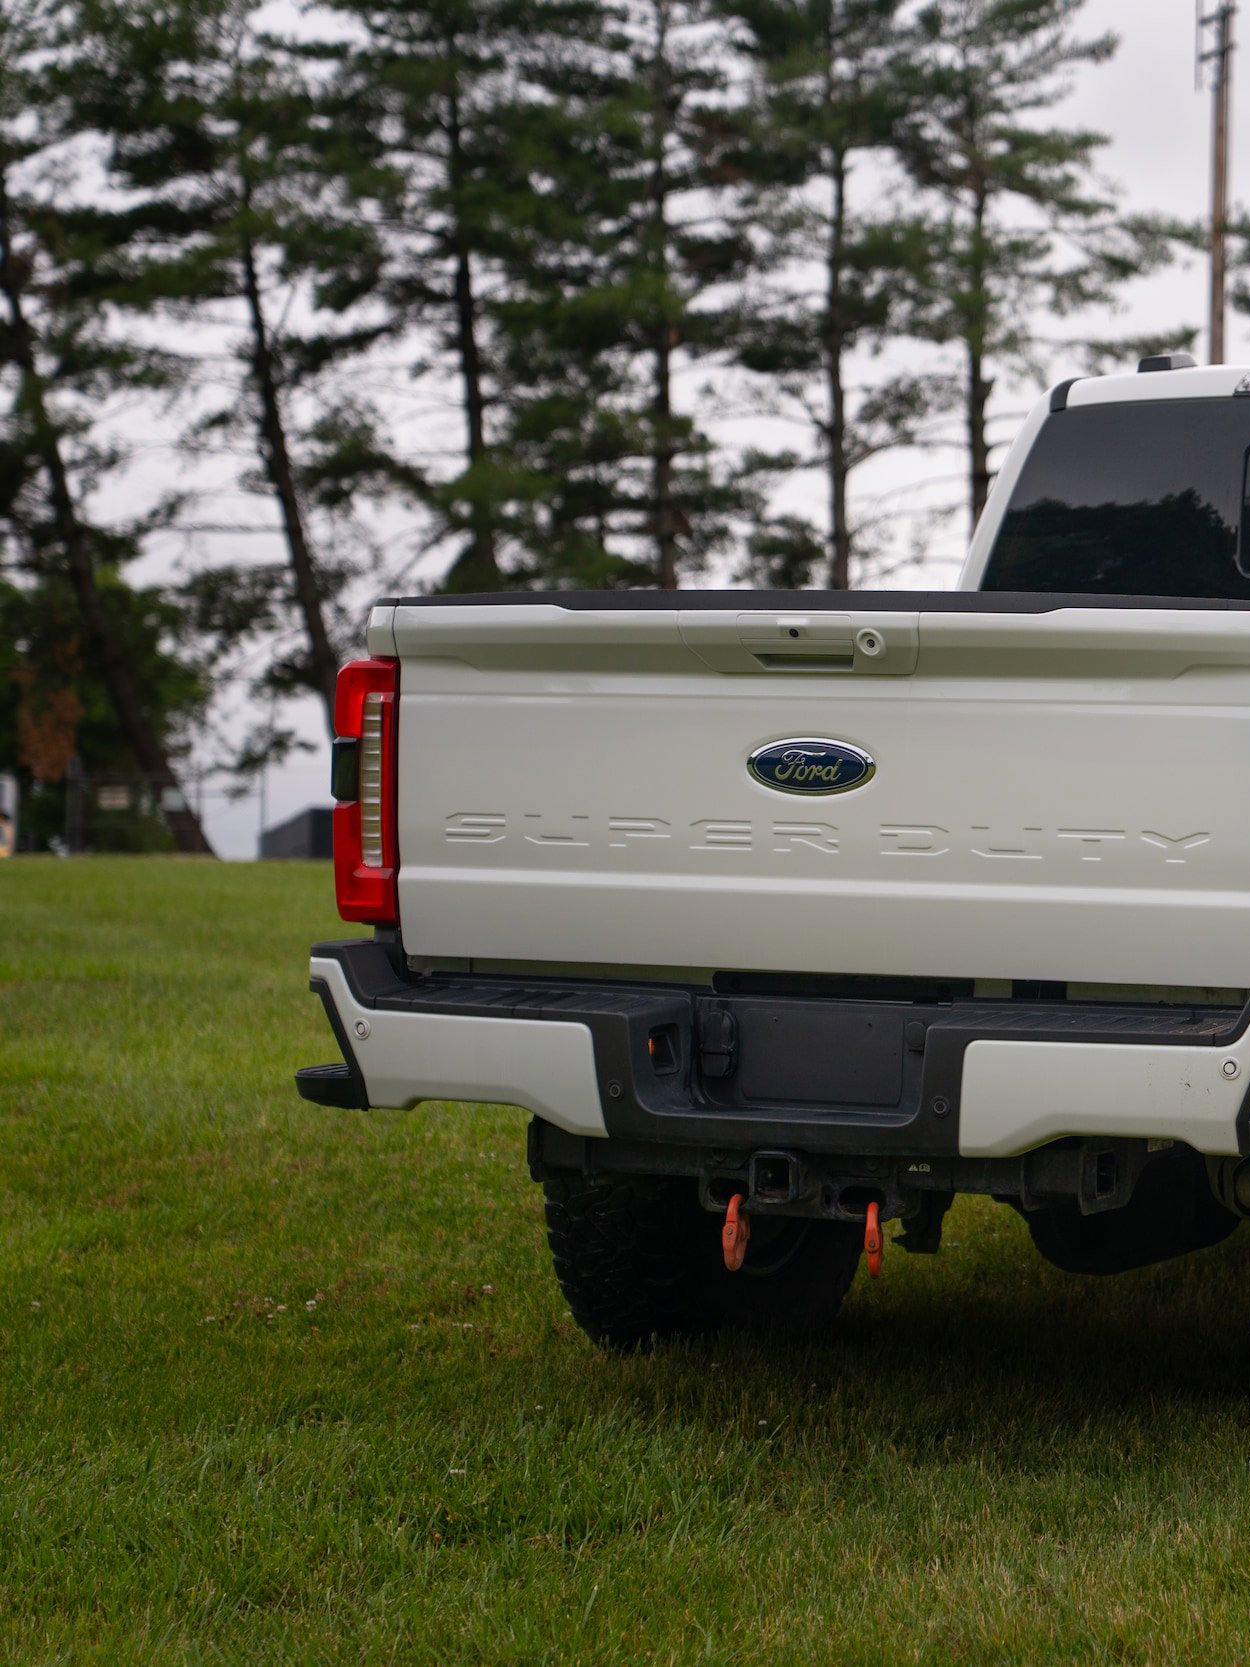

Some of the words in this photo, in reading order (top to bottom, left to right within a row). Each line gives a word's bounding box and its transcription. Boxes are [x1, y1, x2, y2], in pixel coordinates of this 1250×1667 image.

[774, 749, 843, 781] Ford
[445, 812, 839, 854] SUPER
[880, 823, 1211, 863] DUTY
